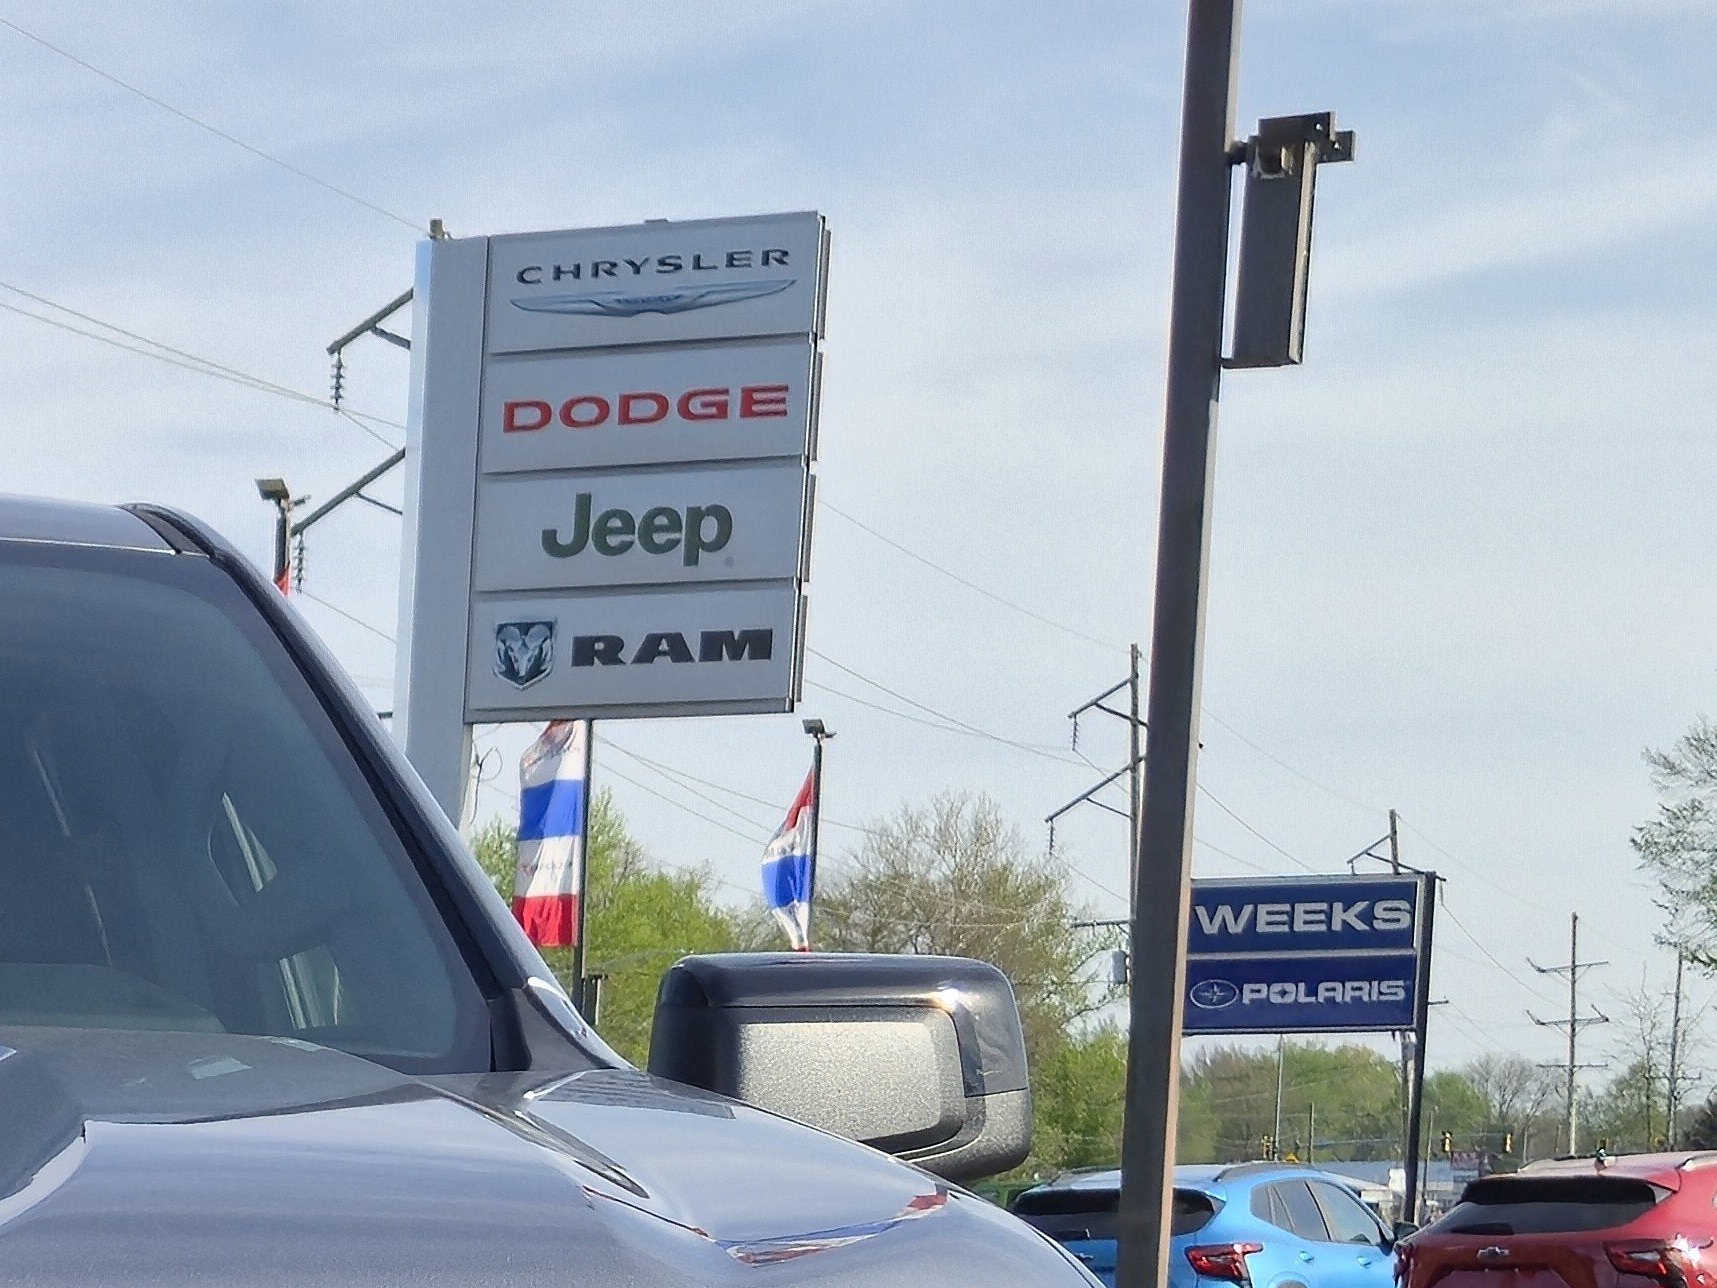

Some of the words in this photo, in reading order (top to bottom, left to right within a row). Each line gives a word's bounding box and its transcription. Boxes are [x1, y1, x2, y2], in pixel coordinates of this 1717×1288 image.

[516, 247, 791, 284] CHRYSLER
[502, 384, 789, 433] DODGE
[541, 492, 733, 567] Jeep
[570, 629, 773, 667] RAM
[1195, 899, 1412, 934] WEEKS
[1242, 979, 1406, 1004] POLARIS
